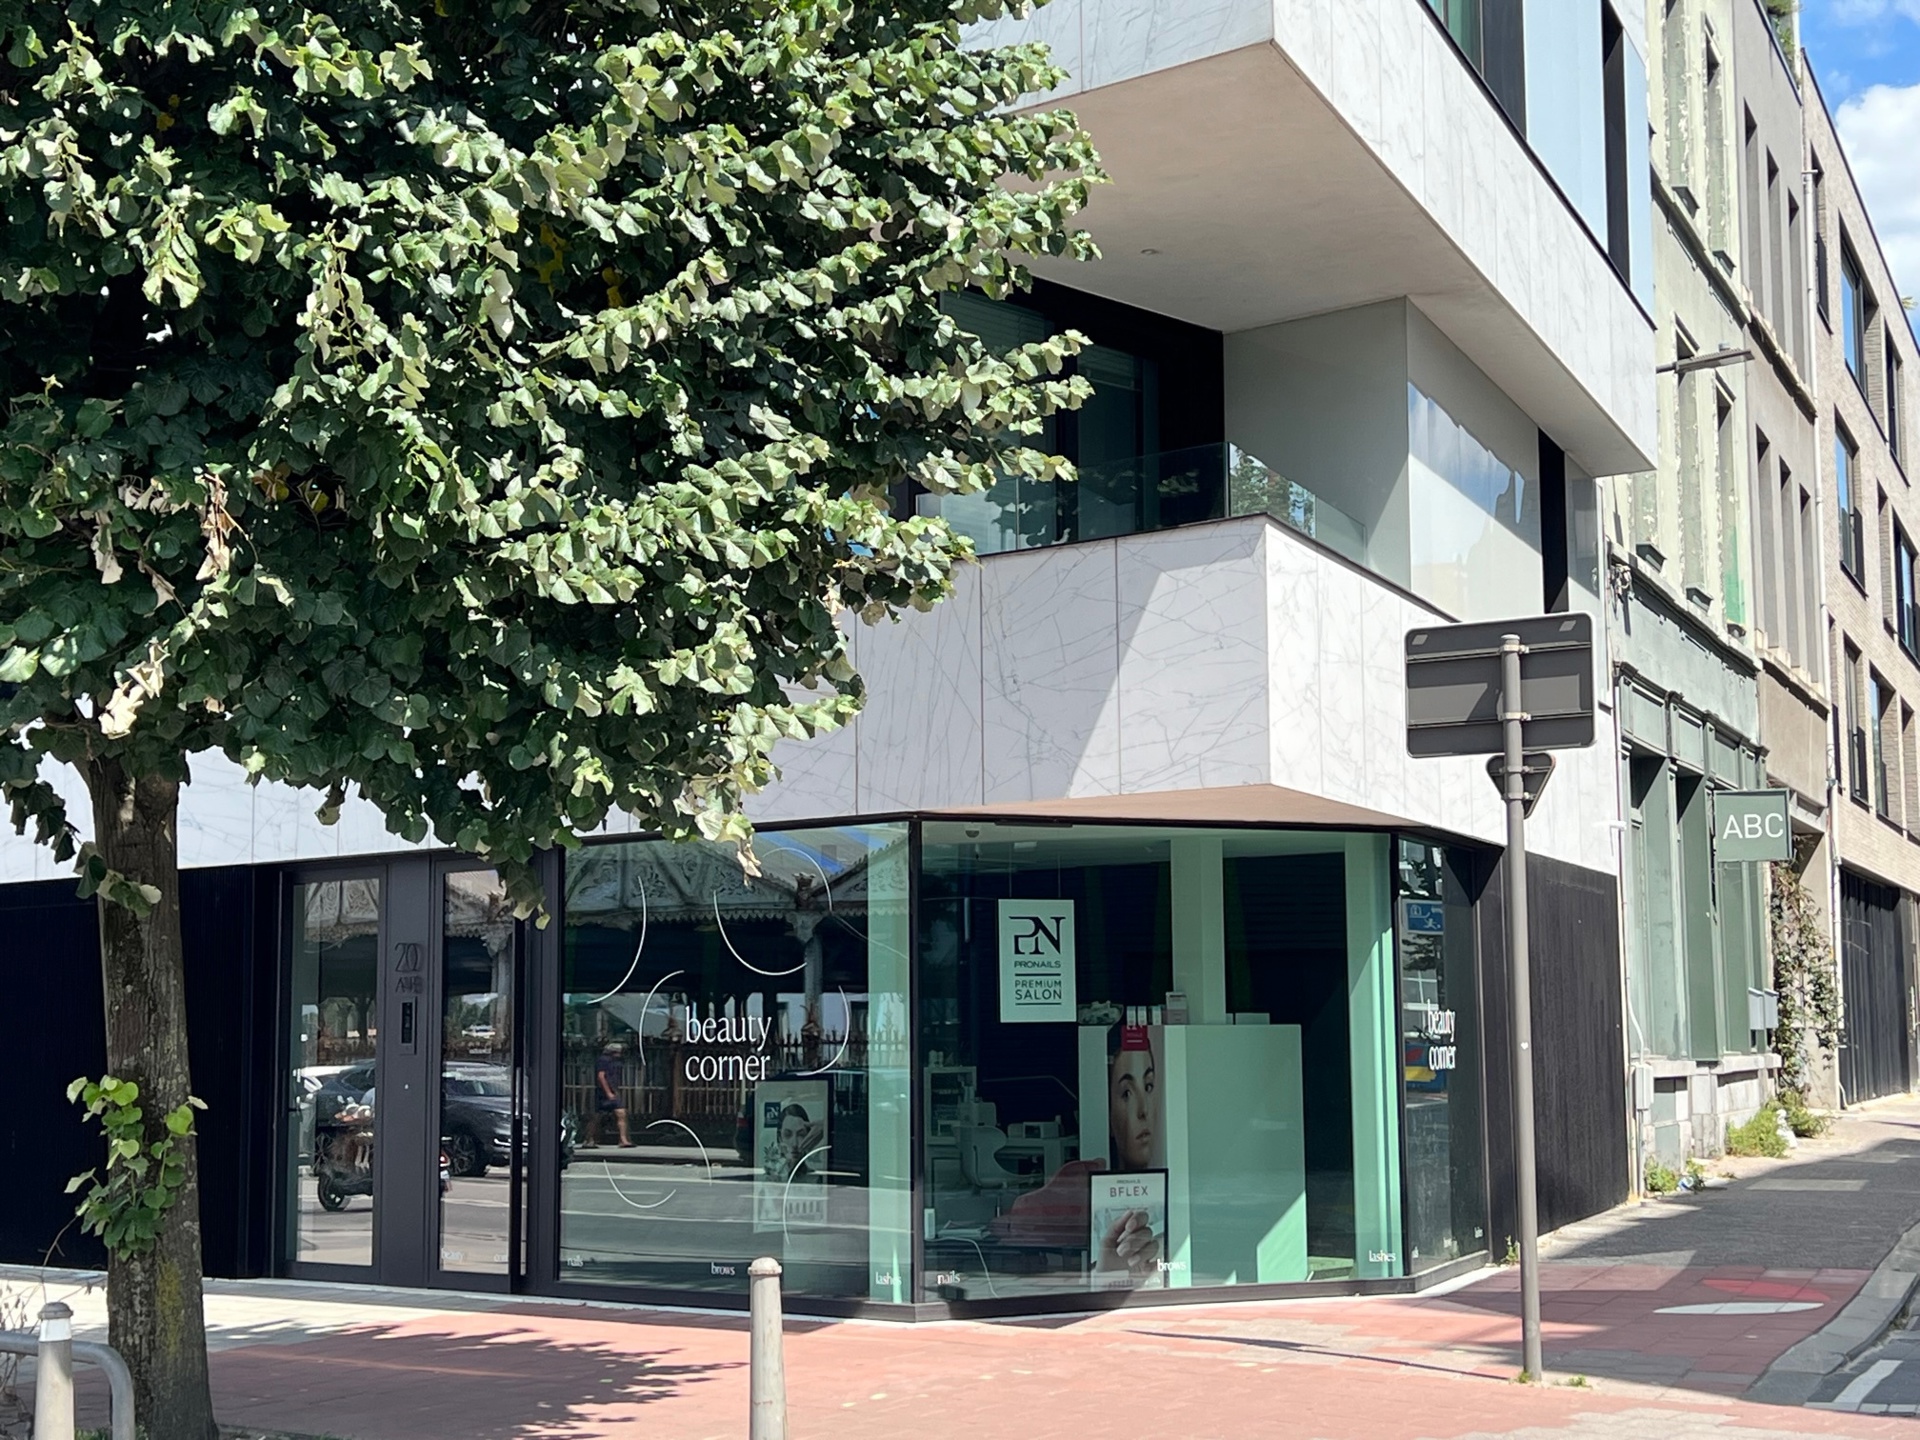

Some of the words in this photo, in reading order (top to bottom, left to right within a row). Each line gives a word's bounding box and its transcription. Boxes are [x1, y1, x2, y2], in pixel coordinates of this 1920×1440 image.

[1722, 813, 1784, 839] ABC
[1008, 916, 1066, 955] PN
[1014, 960, 1062, 969] PRONAILS
[1015, 980, 1062, 989] PREMIUM
[1015, 989, 1062, 1000] SALON
[1427, 998, 1456, 1043] beauty
[685, 1005, 772, 1052] beauty
[1428, 1045, 1457, 1071] corner
[685, 1055, 771, 1081] corner
[1110, 1186, 1149, 1198] BFLEX
[1369, 1249, 1397, 1263] lashes
[1157, 1258, 1187, 1272] brows
[937, 1270, 961, 1285] nails
